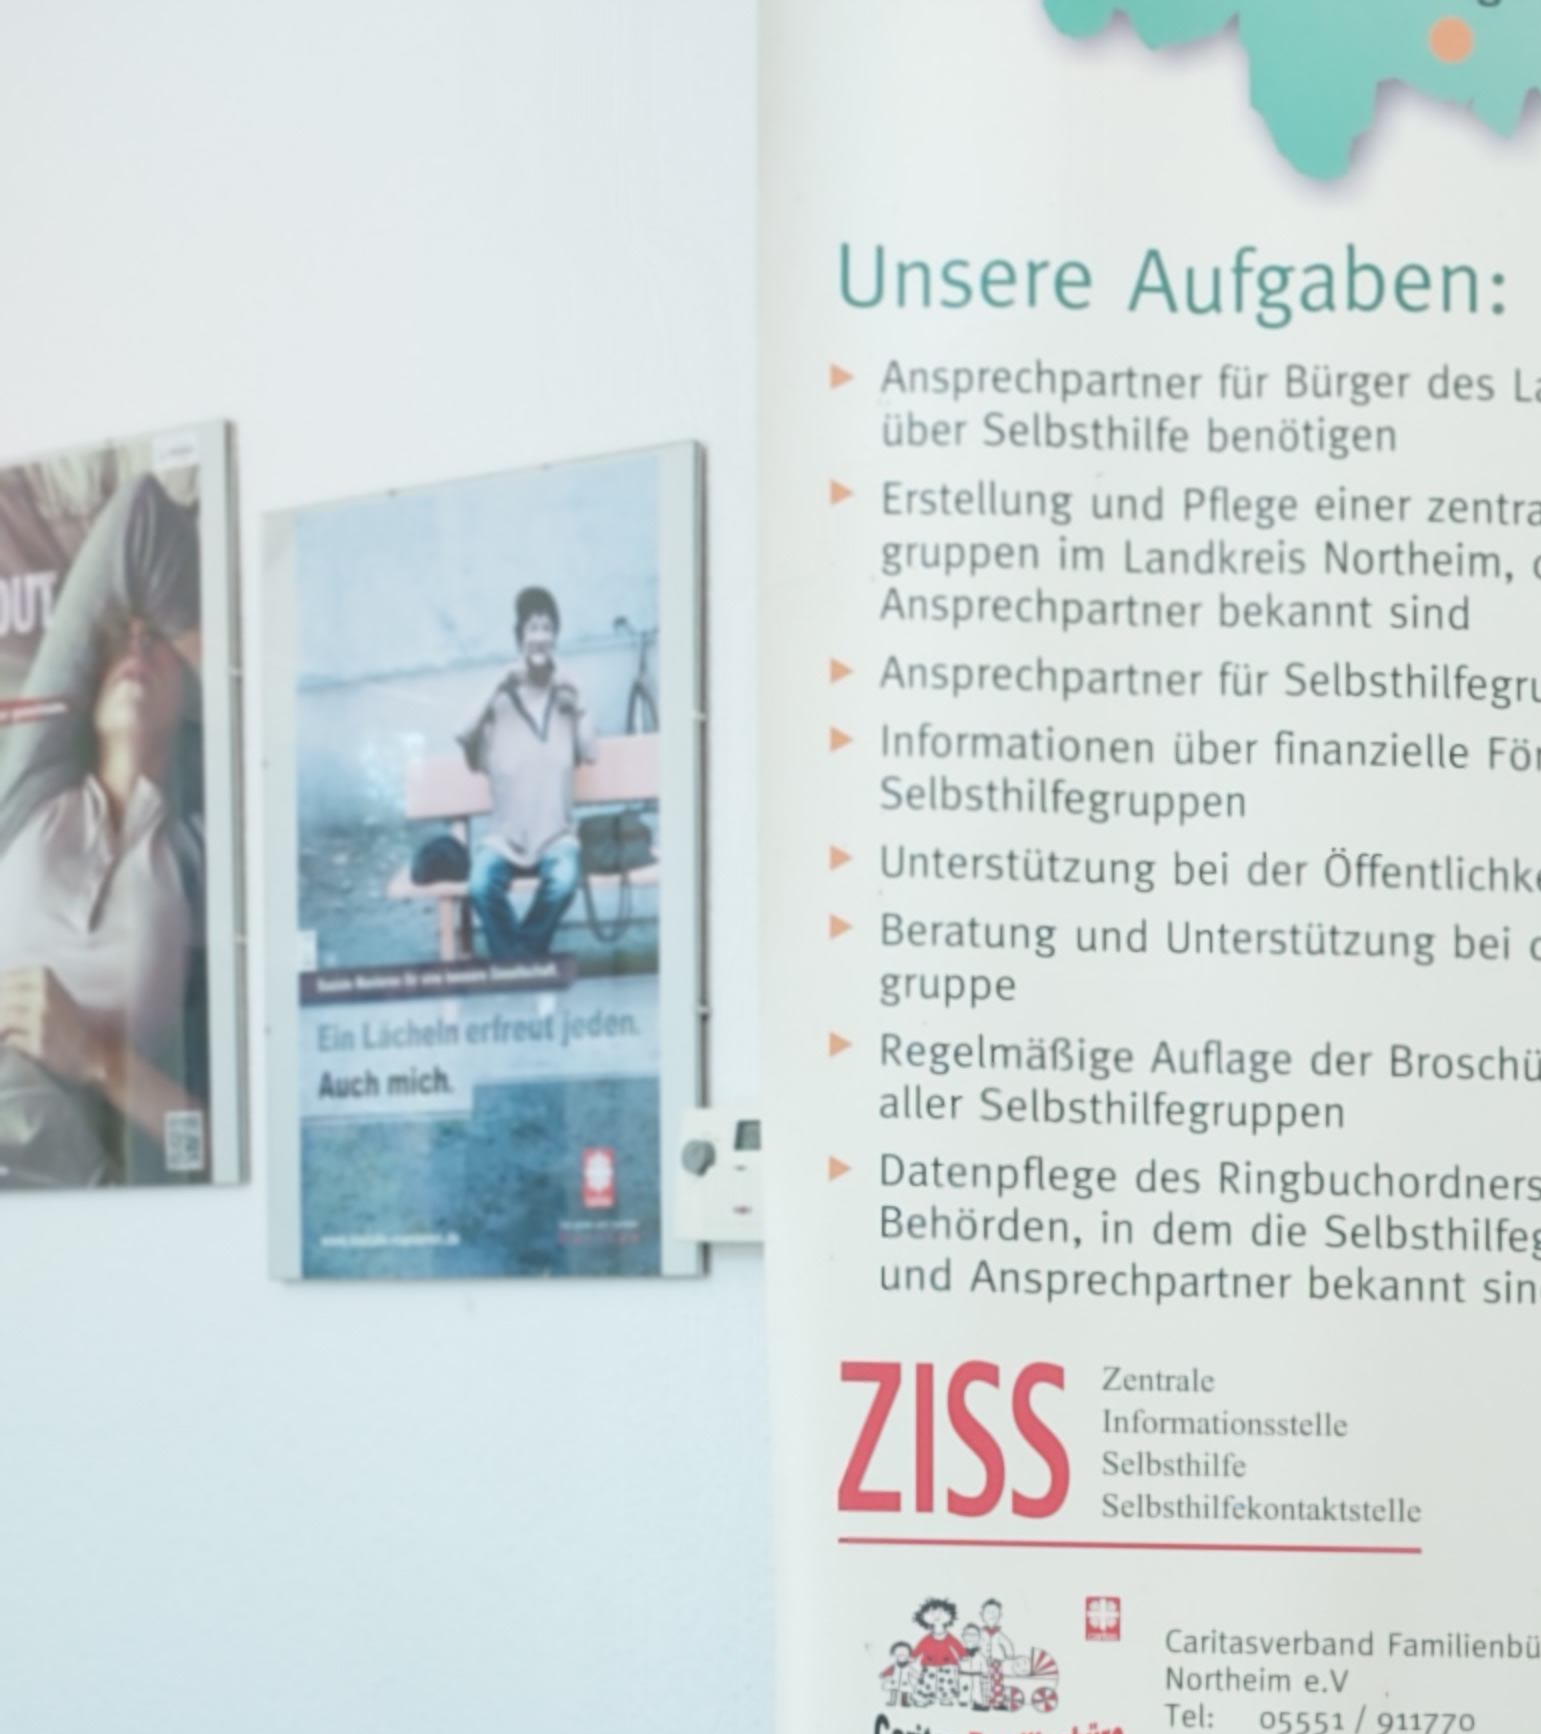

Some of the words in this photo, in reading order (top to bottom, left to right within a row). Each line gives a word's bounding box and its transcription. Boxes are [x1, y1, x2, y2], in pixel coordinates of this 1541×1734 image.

[840, 241, 1093, 311] Unsere
[1127, 242, 1505, 330] Aufgaben:
[881, 358, 1202, 403] Ansprechpartner
[1219, 363, 1268, 400] für
[1286, 363, 1411, 406] Bürger
[1427, 364, 1495, 402] des
[883, 412, 967, 447] über
[983, 412, 1189, 453] Selbsthilfe
[1208, 417, 1396, 460] benötigen
[883, 480, 1073, 526] Erstellung
[1092, 486, 1163, 521] und
[1184, 486, 1298, 530] Pflege
[1315, 485, 1411, 522] einer
[882, 542, 1039, 576] gruppen
[1059, 535, 1104, 572] im
[1125, 539, 1306, 575] Landkreis
[1325, 540, 1514, 584] Northeim,
[880, 587, 1202, 632] Ansprechpartner
[1219, 592, 1372, 629] bekannt
[1390, 594, 1469, 631] sind
[880, 655, 1202, 702] Ansprechpartner
[1219, 661, 1269, 697] für
[882, 722, 1154, 764] Informationen
[1174, 729, 1258, 765] über
[1274, 730, 1469, 769] finanzielle
[881, 775, 1245, 826] Selbsthilfegruppen
[881, 845, 1156, 894] Unterstützung
[1174, 850, 1228, 886] bei
[1247, 851, 1308, 887] der
[881, 912, 1057, 958] Beratung
[1076, 918, 1147, 953] und
[1167, 920, 1436, 966] Unterstützung
[1454, 923, 1510, 960] bei
[880, 973, 1016, 1009] gruppe
[316, 1024, 356, 1052] Ein
[362, 1017, 459, 1050] Lächeln
[465, 1012, 555, 1044] erfreut
[560, 1010, 641, 1048] jeden.
[881, 1033, 1134, 1080] Regelmäßige
[1150, 1039, 1292, 1083] Auflage
[1310, 1041, 1373, 1077] der
[317, 1071, 380, 1099] Auch
[386, 1065, 454, 1096] mich.
[879, 1084, 963, 1120] aller
[980, 1087, 1344, 1136] Selbsthilfegruppen
[881, 1153, 1117, 1200] Datenpflege
[1136, 1158, 1200, 1194] des
[881, 1205, 1082, 1249] Behörden,
[1102, 1210, 1133, 1244] in
[1153, 1210, 1232, 1246] dem
[1251, 1212, 1307, 1248] die
[881, 1257, 951, 1292] und
[970, 1259, 1292, 1306] Ansprechpartner
[1309, 1265, 1465, 1303] bekannt
[1102, 1366, 1215, 1393] Zentrale
[838, 1360, 1070, 1518] ZISS
[1104, 1408, 1348, 1437] Informationsstelle
[1102, 1451, 1246, 1478] Selbsthilfe
[1102, 1493, 1421, 1523] Selbsthilfekontaktstelle
[1165, 1629, 1374, 1656] Caritasverband
[1166, 1666, 1291, 1692] Northeim
[1304, 1669, 1349, 1693] e.V
[1164, 1703, 1214, 1728] Tel:
[1354, 1704, 1367, 1734] /
